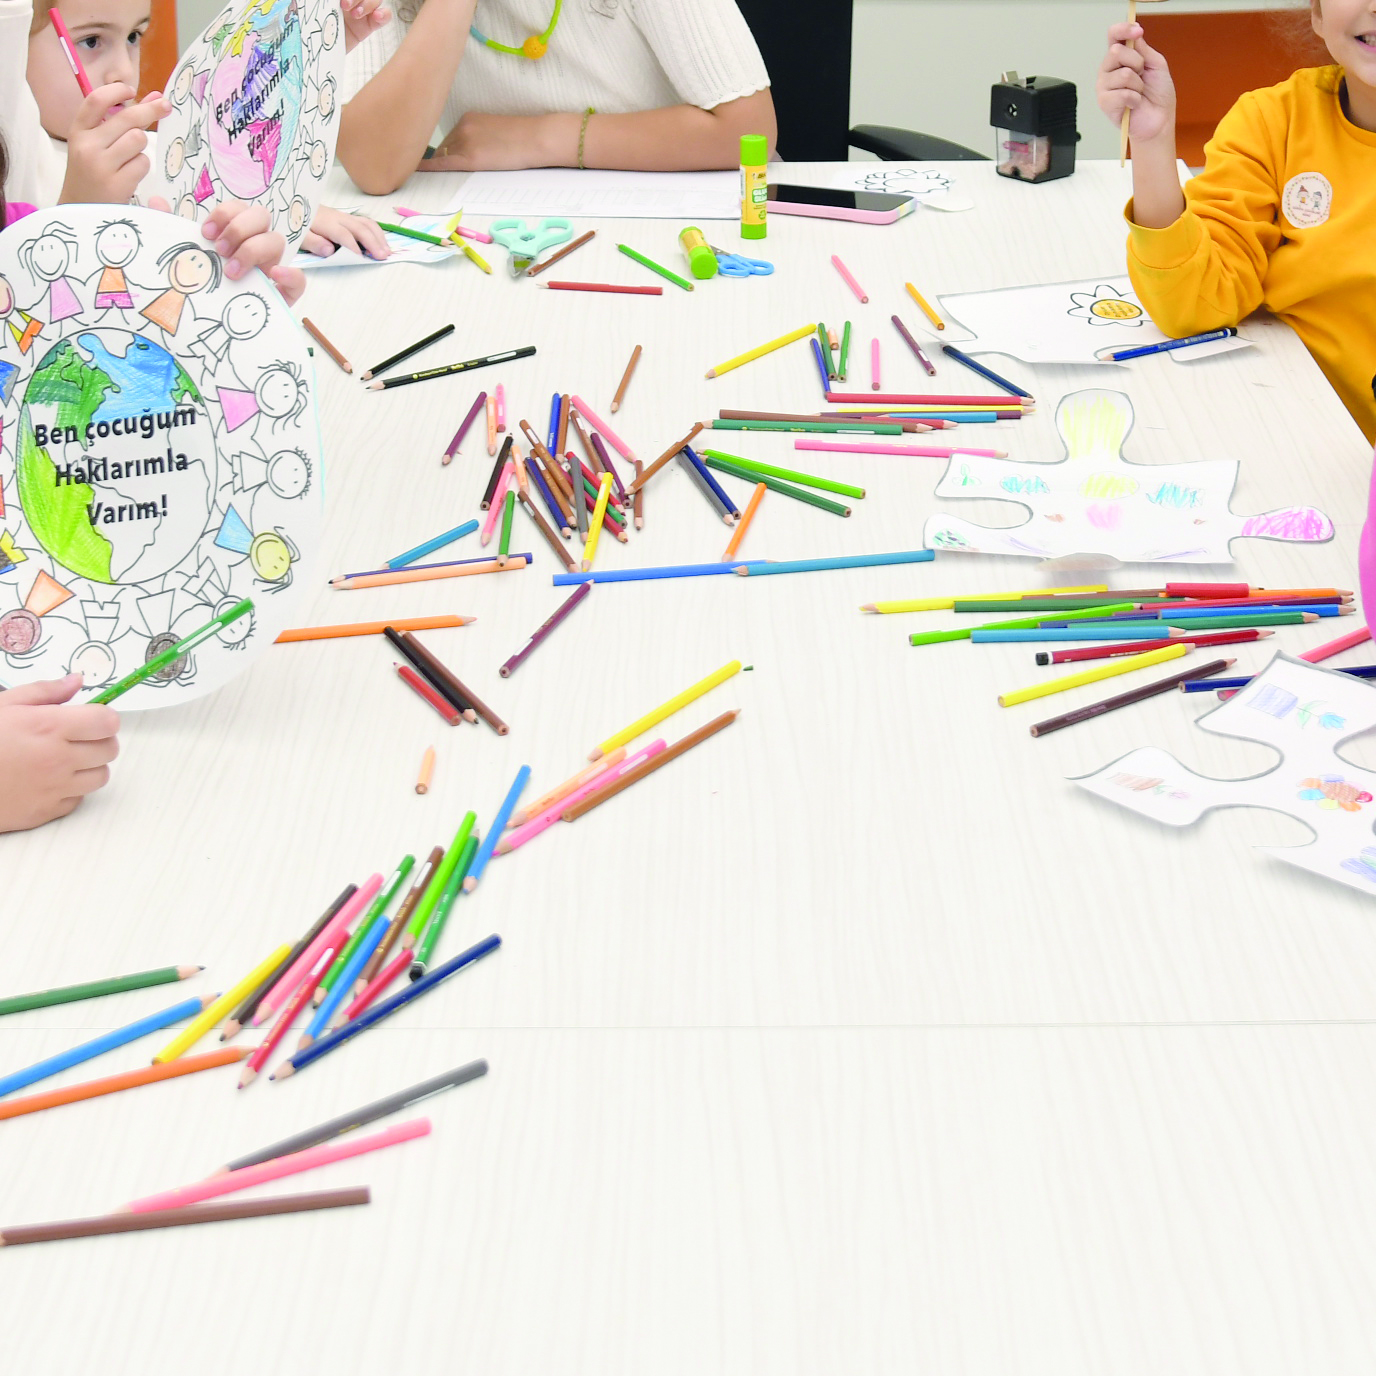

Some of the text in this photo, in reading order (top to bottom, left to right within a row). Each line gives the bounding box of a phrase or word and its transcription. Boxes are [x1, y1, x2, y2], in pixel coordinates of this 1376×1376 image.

[215, 87, 240, 124] Ben
[227, 58, 291, 146] Haklarımla
[247, 97, 285, 158] Varım!
[34, 407, 197, 447] Ben çocuğum
[54, 449, 190, 488] Haklarımla
[86, 493, 169, 526] Varım!
